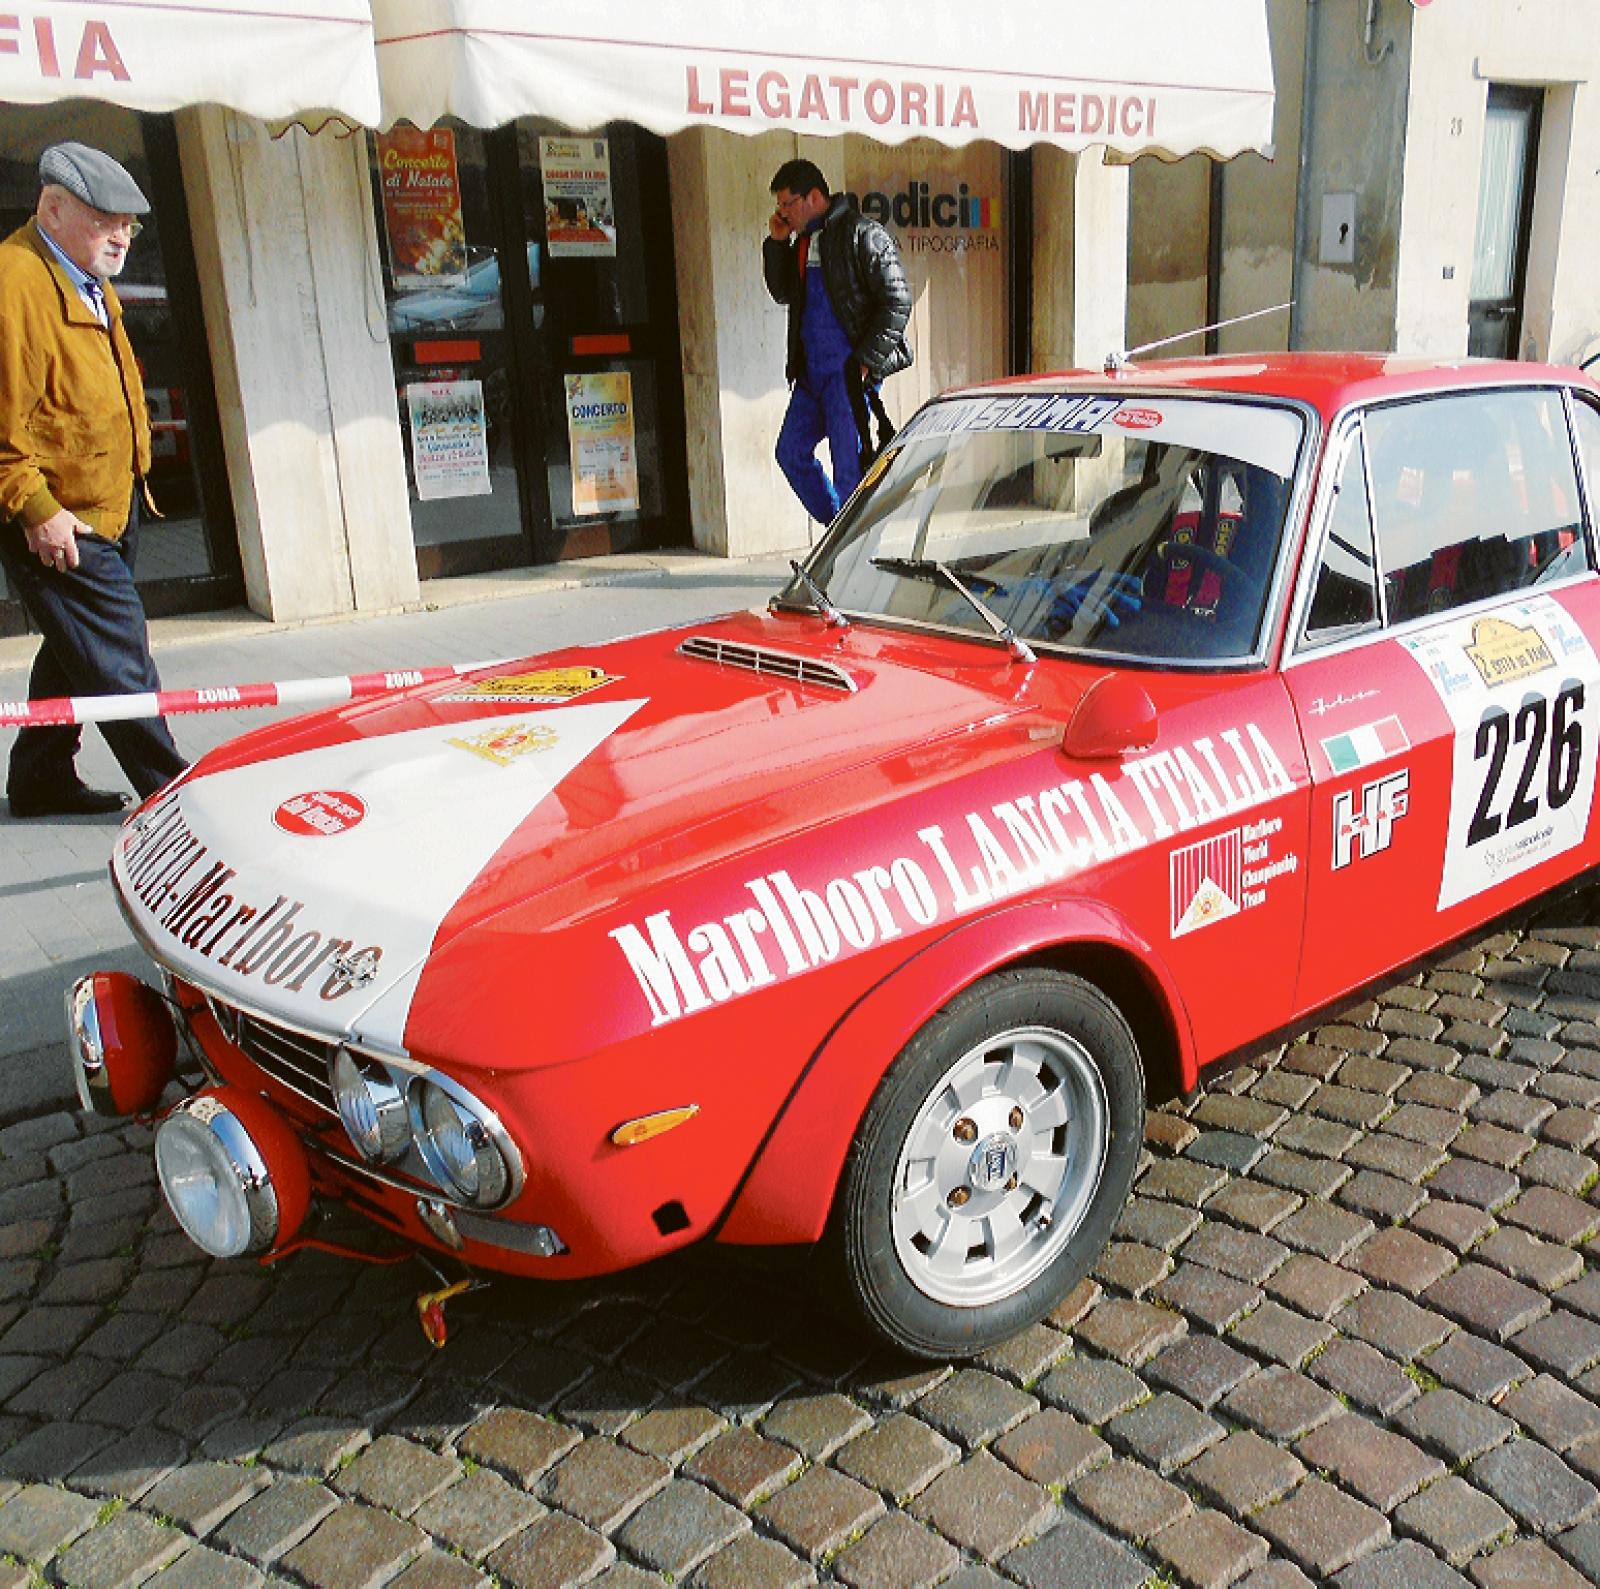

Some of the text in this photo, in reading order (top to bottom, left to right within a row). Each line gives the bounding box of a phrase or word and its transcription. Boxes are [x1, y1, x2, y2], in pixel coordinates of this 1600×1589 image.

[685, 65, 1158, 137] LEGATORIA MEDICI
[907, 235, 1000, 253] TIPOGRAFIA
[572, 402, 628, 419] CONCERTO
[197, 687, 241, 704] ZONA
[384, 671, 425, 689] ZONA
[1466, 678, 1586, 848] 226
[1331, 767, 1410, 872] HF
[608, 723, 1297, 1027] Marlboro LANCIA ITALIA
